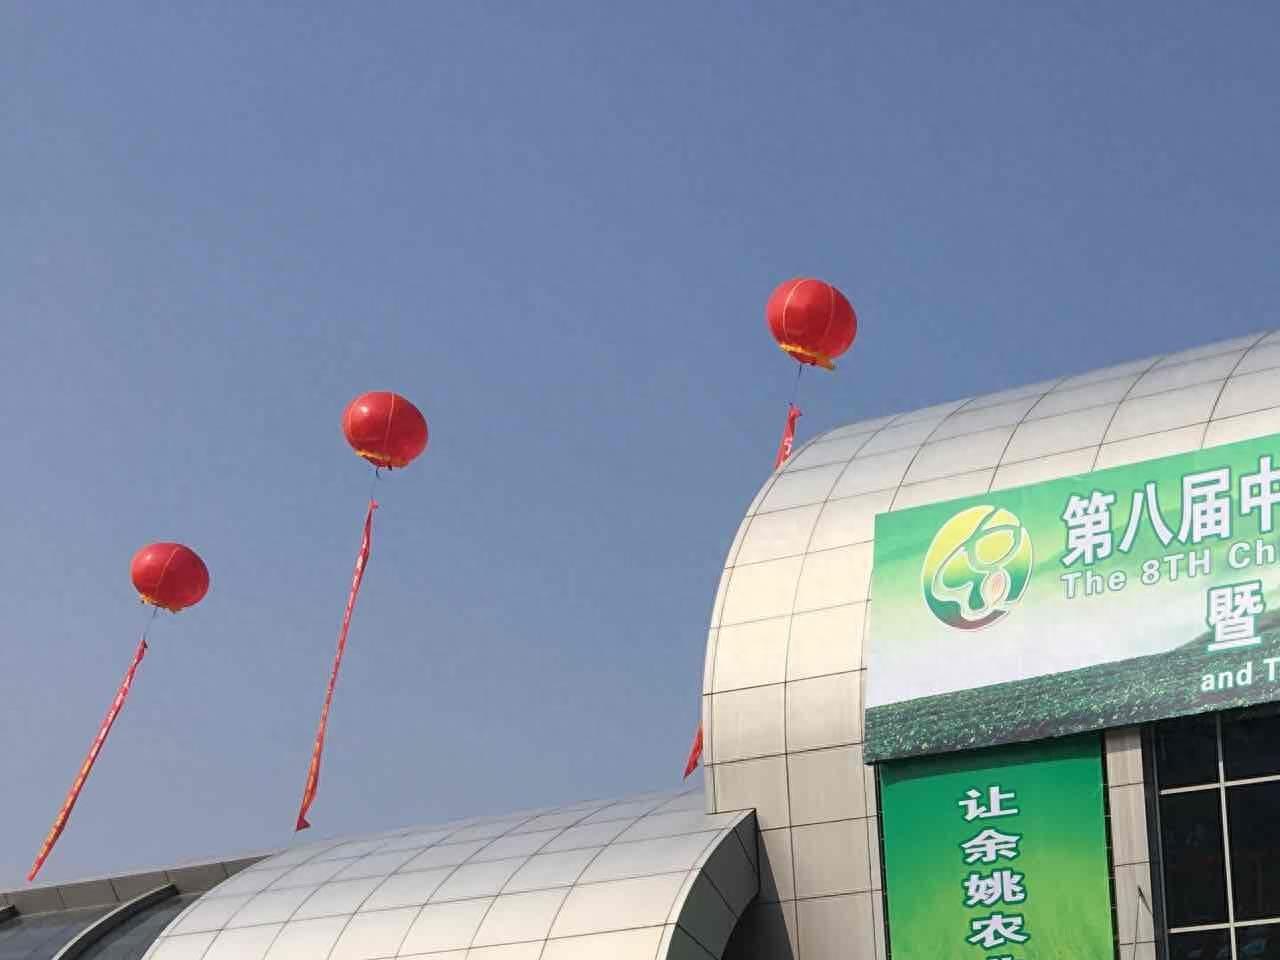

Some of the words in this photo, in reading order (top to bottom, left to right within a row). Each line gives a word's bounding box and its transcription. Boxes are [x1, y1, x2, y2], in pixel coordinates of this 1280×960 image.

[1060, 569, 1126, 600] The
[1141, 550, 1211, 585] 8TH
[1201, 661, 1252, 692] and
